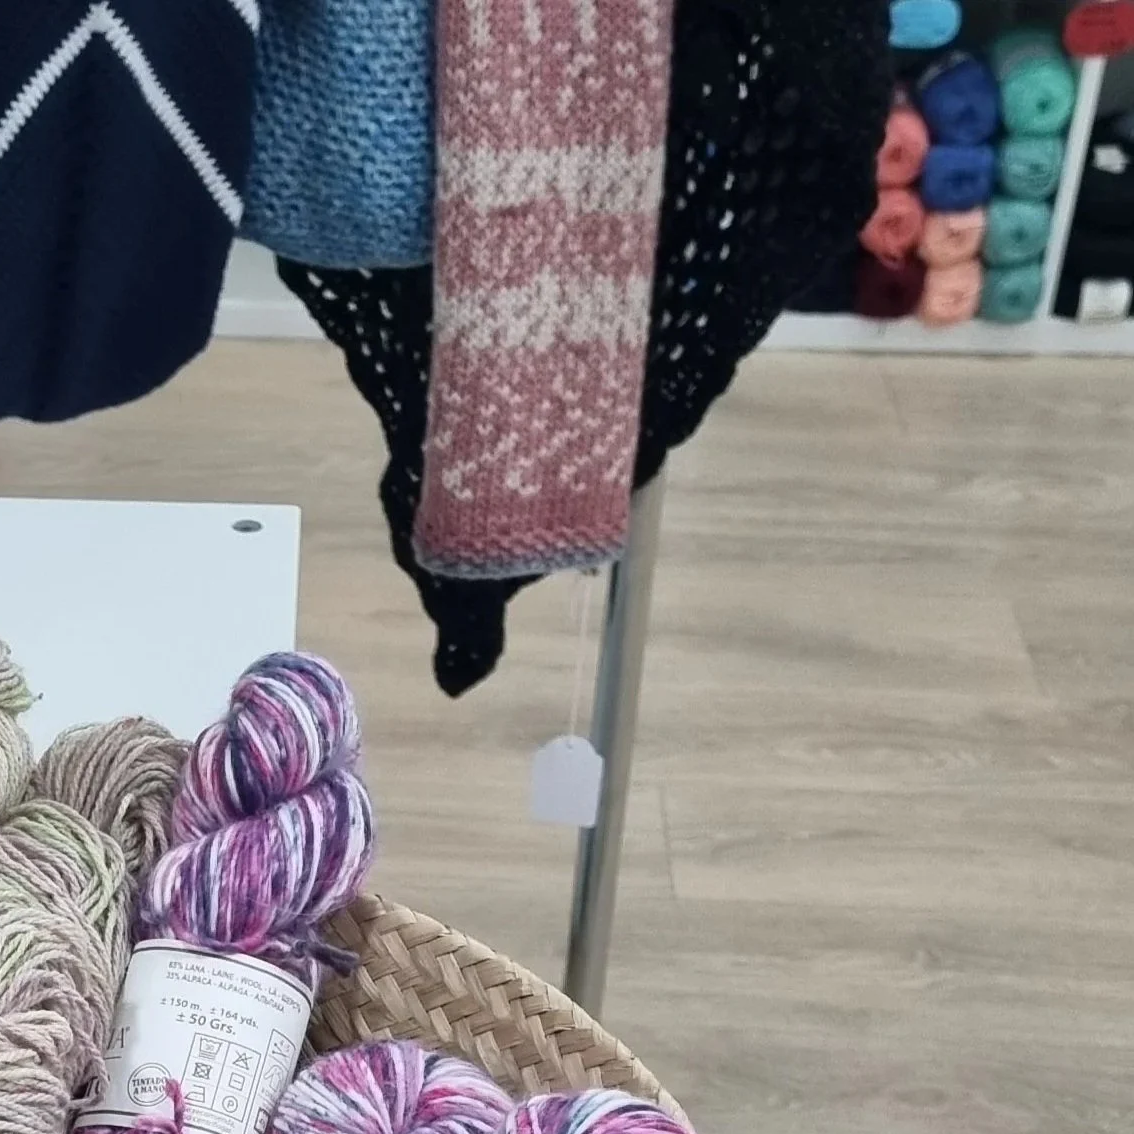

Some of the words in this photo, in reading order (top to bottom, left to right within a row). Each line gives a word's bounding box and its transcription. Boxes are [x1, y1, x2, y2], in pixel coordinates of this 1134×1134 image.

[186, 962, 205, 973] LANA
[181, 974, 212, 986] ALPACA
[170, 997, 188, 1008] 150
[220, 1007, 238, 1020] 164
[189, 1013, 207, 1026] 50
[210, 1018, 237, 1036] Grs.
